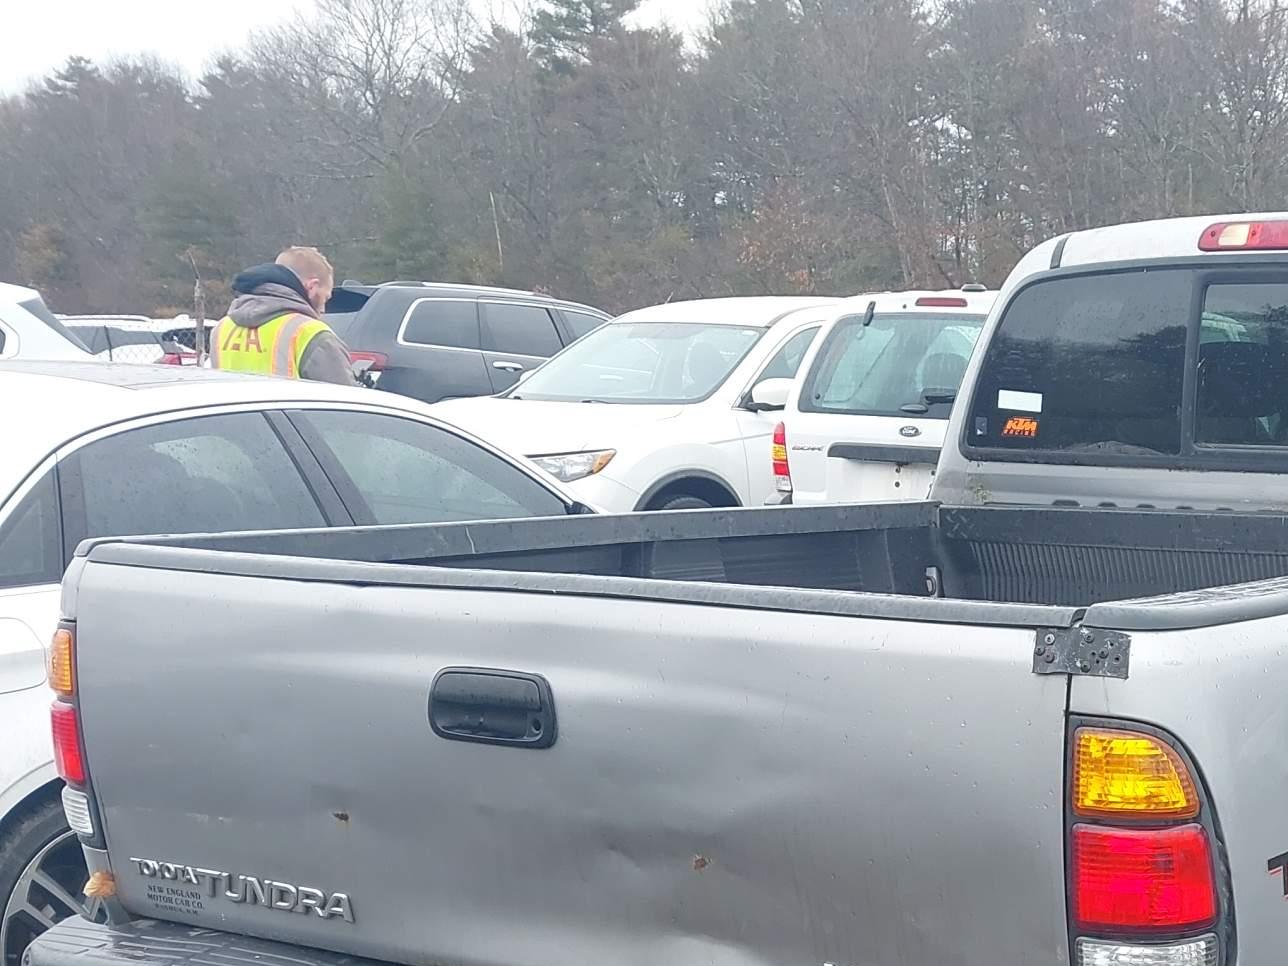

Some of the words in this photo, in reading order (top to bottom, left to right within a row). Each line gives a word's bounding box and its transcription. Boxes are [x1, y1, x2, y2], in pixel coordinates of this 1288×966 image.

[1006, 417, 1038, 431] KTM
[129, 857, 198, 884] TOYOTA
[196, 868, 355, 924] TUNDRA
[166, 887, 201, 900] ENGLAND
[147, 892, 174, 905] MOTOR
[174, 897, 190, 908] CAR
